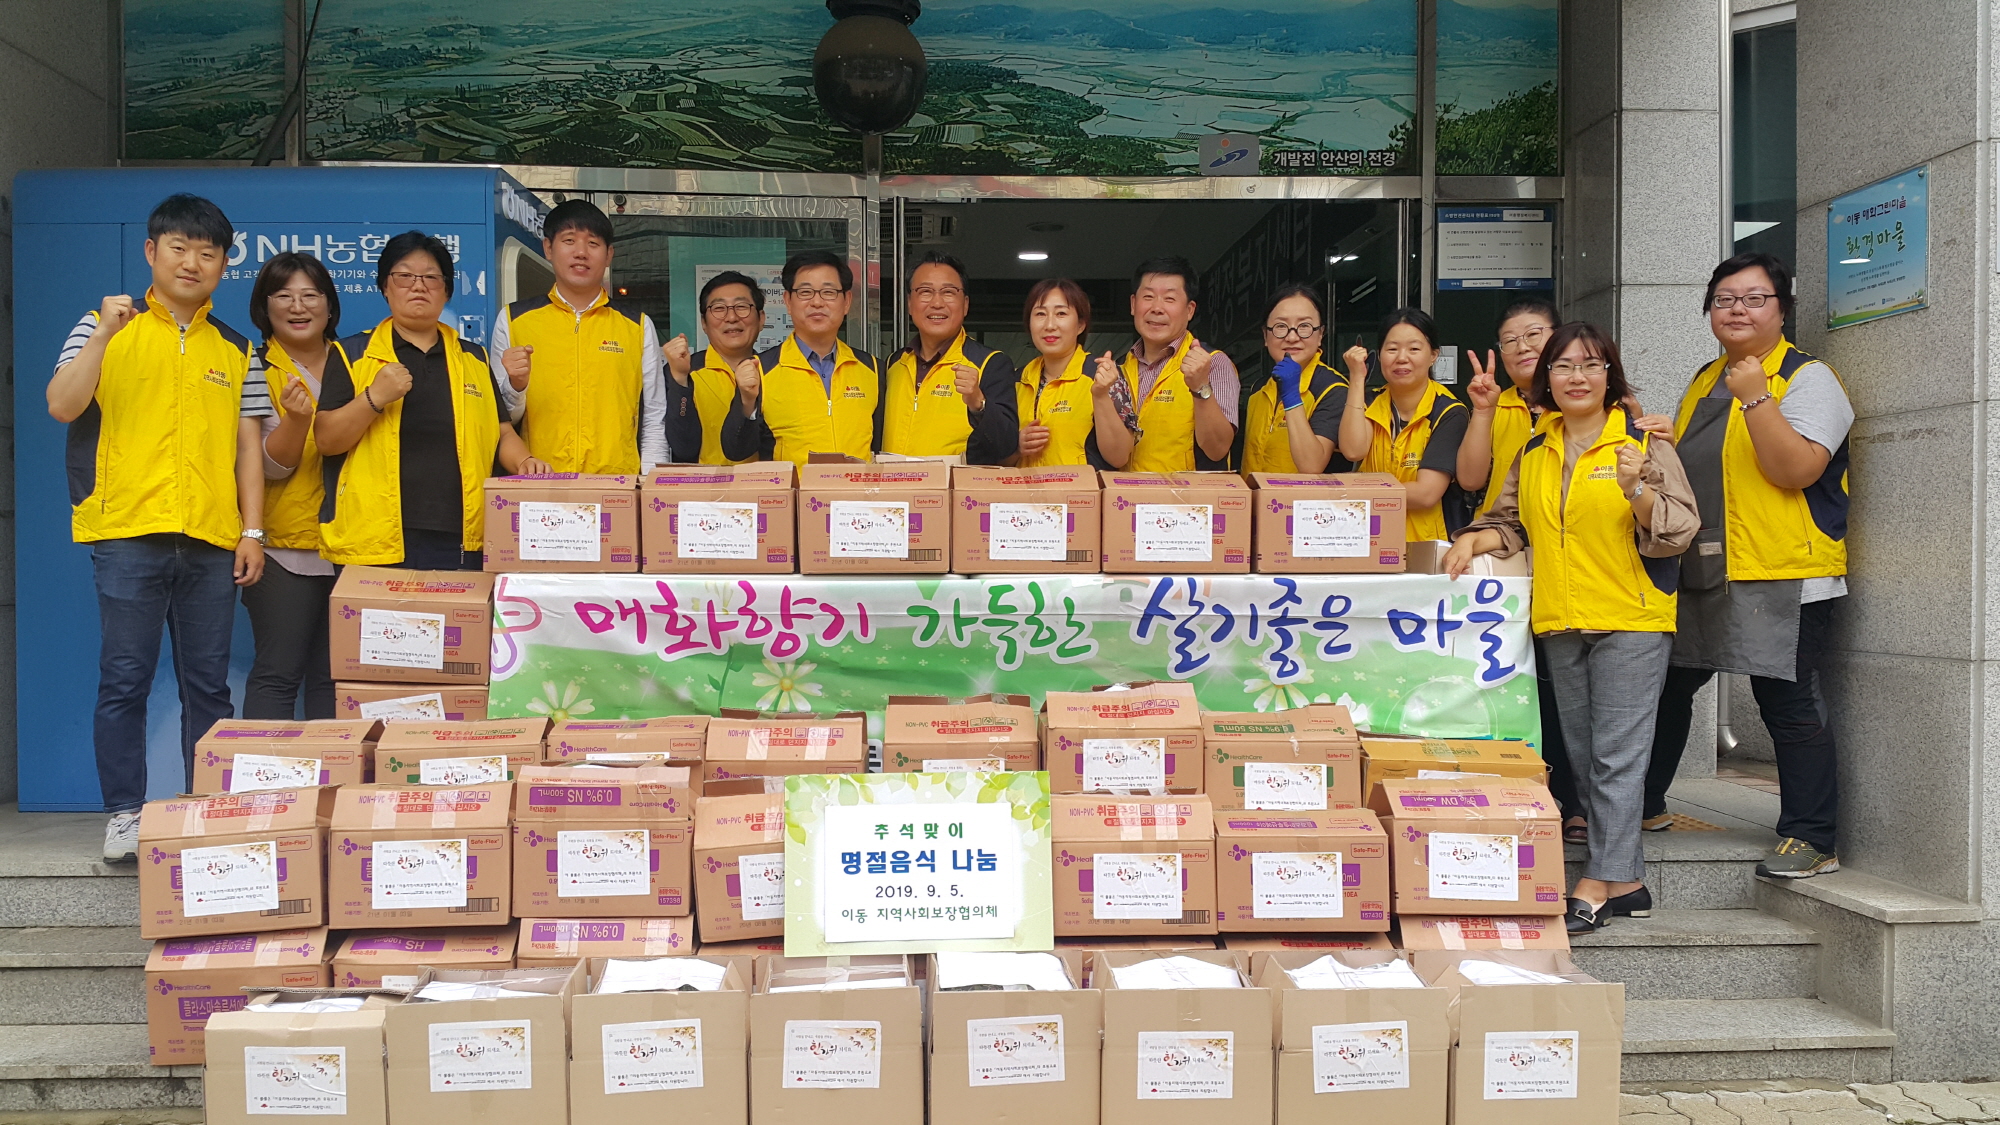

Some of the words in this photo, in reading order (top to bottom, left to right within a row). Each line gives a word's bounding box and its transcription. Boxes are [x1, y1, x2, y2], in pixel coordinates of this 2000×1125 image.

[1274, 152, 1316, 167] 개발전
[1321, 152, 1362, 167] 안산의
[1368, 151, 1396, 167] 전경
[1847, 212, 1861, 225] 이동
[1863, 196, 1907, 220] 매화그린마을
[1847, 221, 1906, 259] 환경마을
[257, 233, 460, 264] NH농협행
[344, 284, 363, 293] 제휴
[215, 371, 226, 379] 이동
[541, 514, 564, 527] 한가위
[699, 518, 722, 531] 한가위
[851, 517, 874, 530] 한가위
[1011, 515, 1032, 528] 한가위
[1156, 516, 1178, 529] 한가위
[1314, 512, 1336, 525] 한가위
[383, 627, 407, 640] 한가위
[577, 580, 870, 656] 매화향기
[907, 584, 1093, 665] 가득한
[1137, 576, 1352, 678] 살기좋은
[1387, 578, 1515, 681] 마을
[931, 720, 969, 728] 취급주의
[1105, 751, 1128, 764] 한가위
[255, 767, 280, 782] 한가위
[444, 771, 468, 785] 한가위
[1267, 775, 1290, 788] 한가위
[388, 792, 433, 802] 취급주의
[538, 789, 564, 797] 500mL
[568, 790, 583, 803] NS
[587, 790, 613, 803] 0.9%
[1441, 798, 1458, 806] DW
[1097, 805, 1138, 816] 취급주의
[717, 817, 741, 825] NON-PVC
[582, 844, 608, 859] 한가위
[1453, 847, 1478, 861] 한가위
[207, 861, 234, 875] 한가위
[398, 855, 424, 869] 한가위
[841, 850, 936, 875] 명절음식
[952, 849, 997, 872] 나눔
[1117, 867, 1142, 881] 한가위
[1277, 866, 1302, 880] 한가위
[875, 886, 918, 899] 2019.
[927, 885, 940, 898] 9.
[950, 885, 964, 897] 5.
[841, 908, 868, 924] 이동
[877, 905, 998, 922] 지역사회보장협의체
[573, 926, 589, 939] NS
[593, 926, 618, 938] 0.9%
[405, 941, 425, 950] HS
[457, 1042, 485, 1057] 한가위
[630, 1043, 657, 1058] 한가위
[810, 1040, 837, 1056] 한가위
[994, 1038, 1020, 1053] 한가위
[1339, 1045, 1365, 1060] 한가위
[1164, 1051, 1190, 1066] 한가위
[1510, 1051, 1536, 1067] 한가위
[272, 1067, 300, 1082] 한가위
